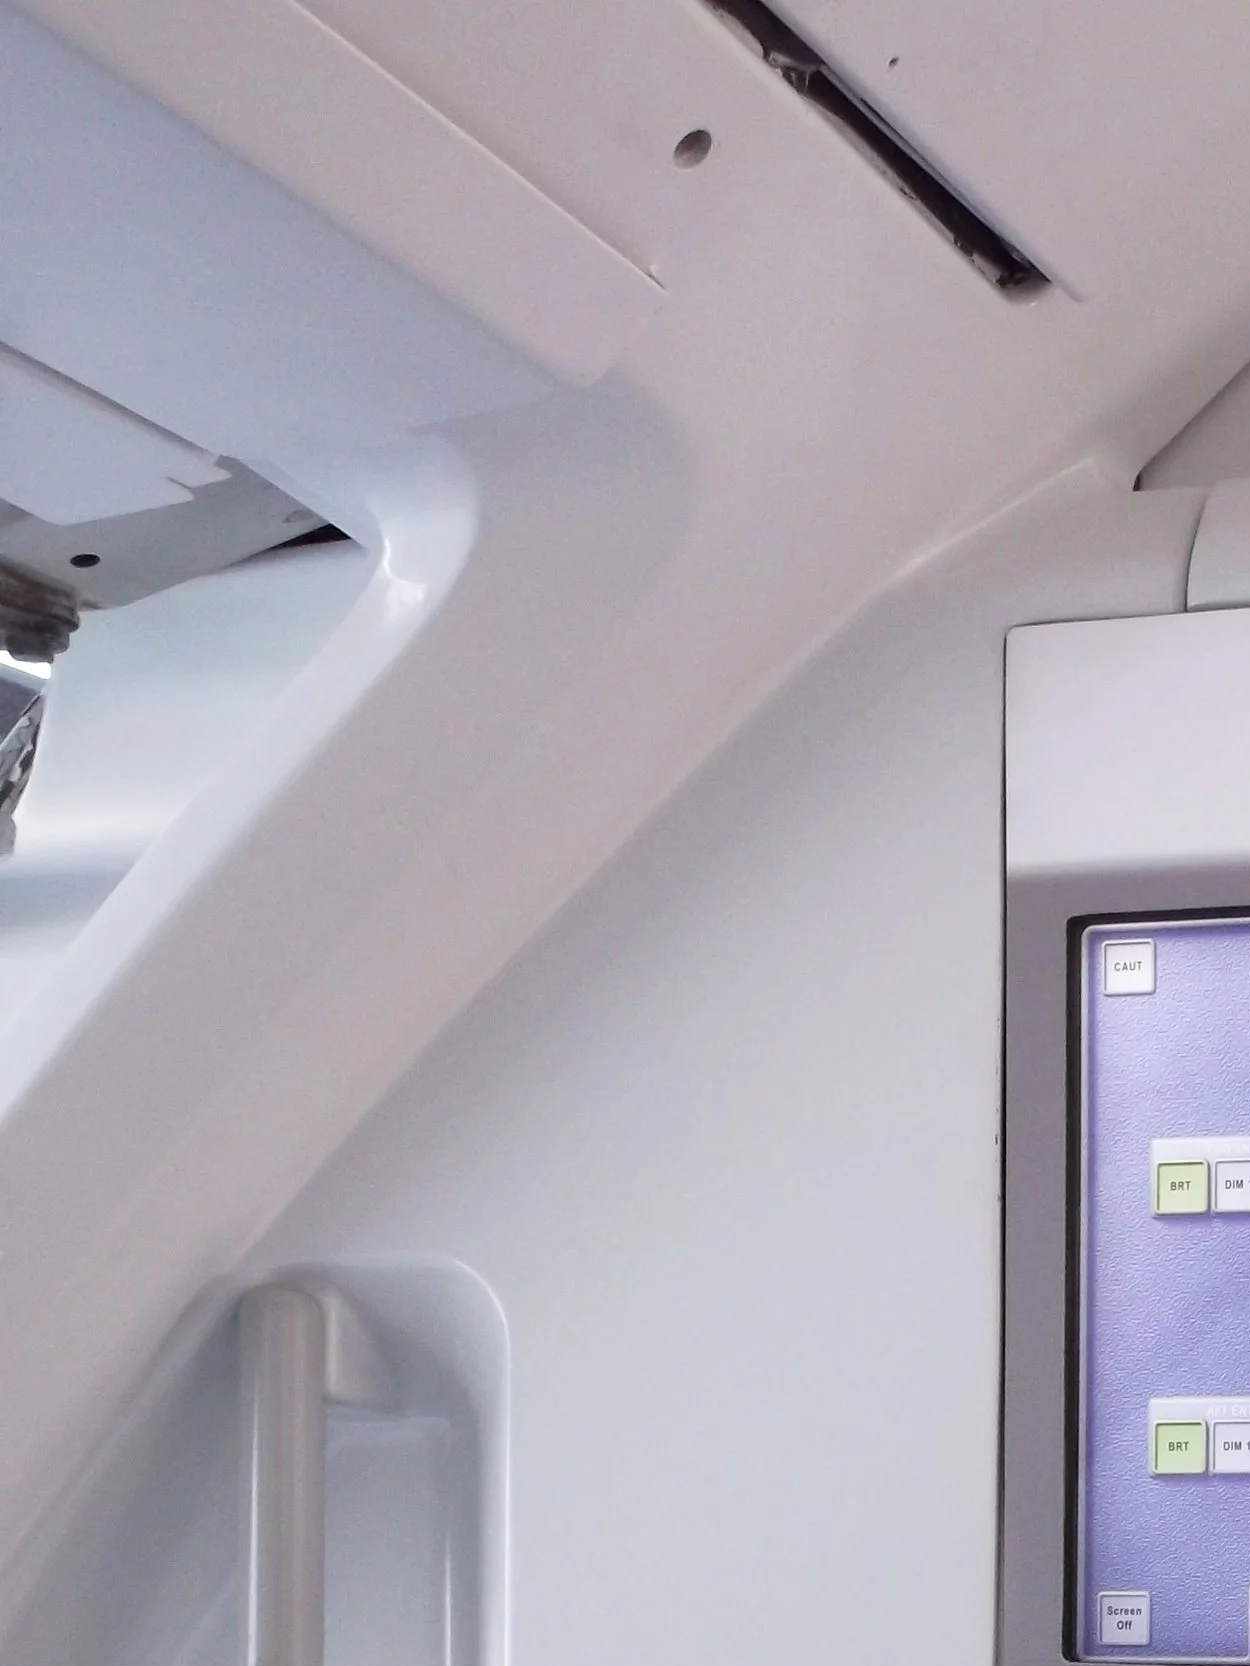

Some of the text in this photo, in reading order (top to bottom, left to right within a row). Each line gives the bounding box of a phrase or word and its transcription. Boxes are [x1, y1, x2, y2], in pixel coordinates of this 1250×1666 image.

[1113, 960, 1143, 972] CAUT
[1170, 1180, 1192, 1192] BRT
[1224, 1179, 1244, 1190] DIM
[1168, 1441, 1190, 1452] BRT
[1223, 1440, 1242, 1451] DIM
[1106, 1605, 1143, 1617] Screen
[1116, 1620, 1133, 1631] Off
